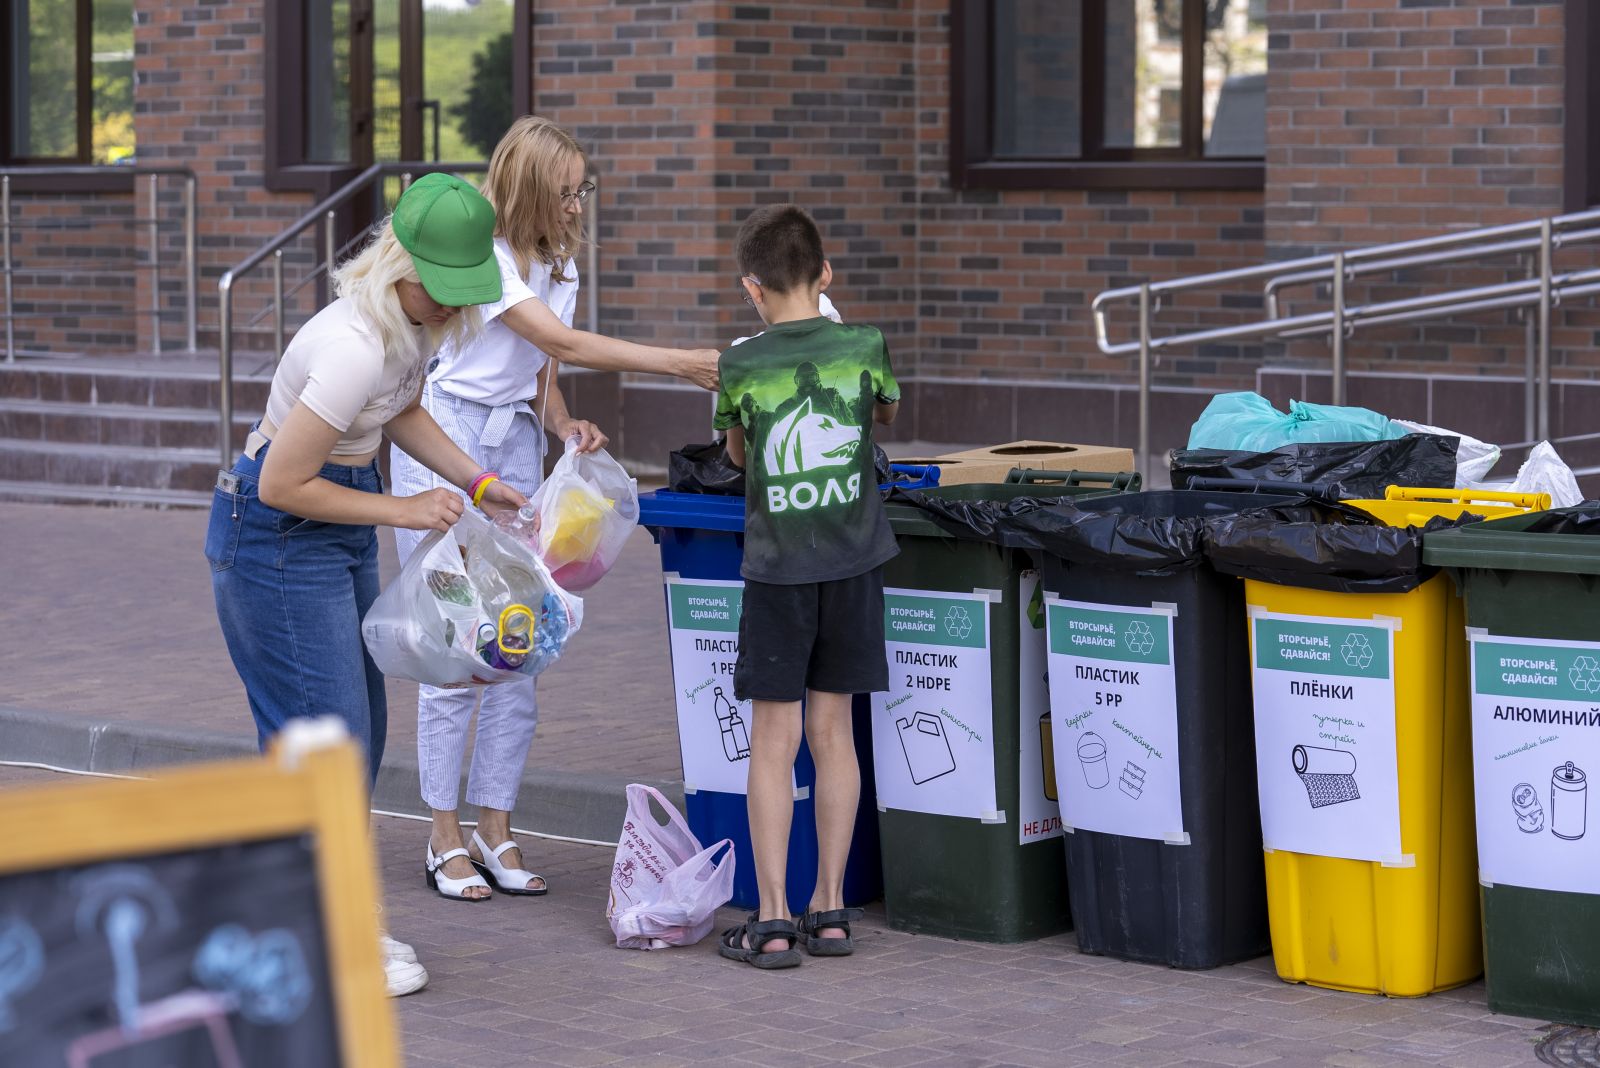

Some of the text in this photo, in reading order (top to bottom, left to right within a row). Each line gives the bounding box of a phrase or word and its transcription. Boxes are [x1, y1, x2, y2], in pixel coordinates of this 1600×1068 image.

[766, 472, 861, 513] ВОЛЯ
[688, 597, 729, 608] ВТОРСЫРЬЁ,
[690, 609, 730, 620] СДАВАЙСЯ!
[890, 607, 936, 620] ВТОРСЫРЬЁ,
[892, 620, 936, 632] СДАВАЙСЯ!
[1069, 620, 1116, 635] ВТОРСЫРЬЁ,
[695, 639, 739, 653] ПЛАСТИ
[1071, 634, 1116, 648] СДАВАЙСЯ!
[1278, 633, 1331, 649] ВТОРСЫРЬЁ,
[896, 651, 958, 669] ПЛАСТИК
[1280, 648, 1331, 661] СДАВАЙСЯ!
[711, 662, 717, 674] 1
[1500, 658, 1558, 672] ВТОРСЫРЬЁ,
[1076, 665, 1140, 685] ПЛАСТИК
[1502, 673, 1558, 686] СДАВАЙСЯ!
[906, 675, 951, 691] 2 HDPE
[1290, 680, 1353, 700] ПЛЁНКИ
[1095, 692, 1123, 707] 5 PP
[1493, 705, 1600, 727] АЛЮМИНИЙ
[1024, 821, 1039, 836] НЕ
[624, 839, 634, 850] за
